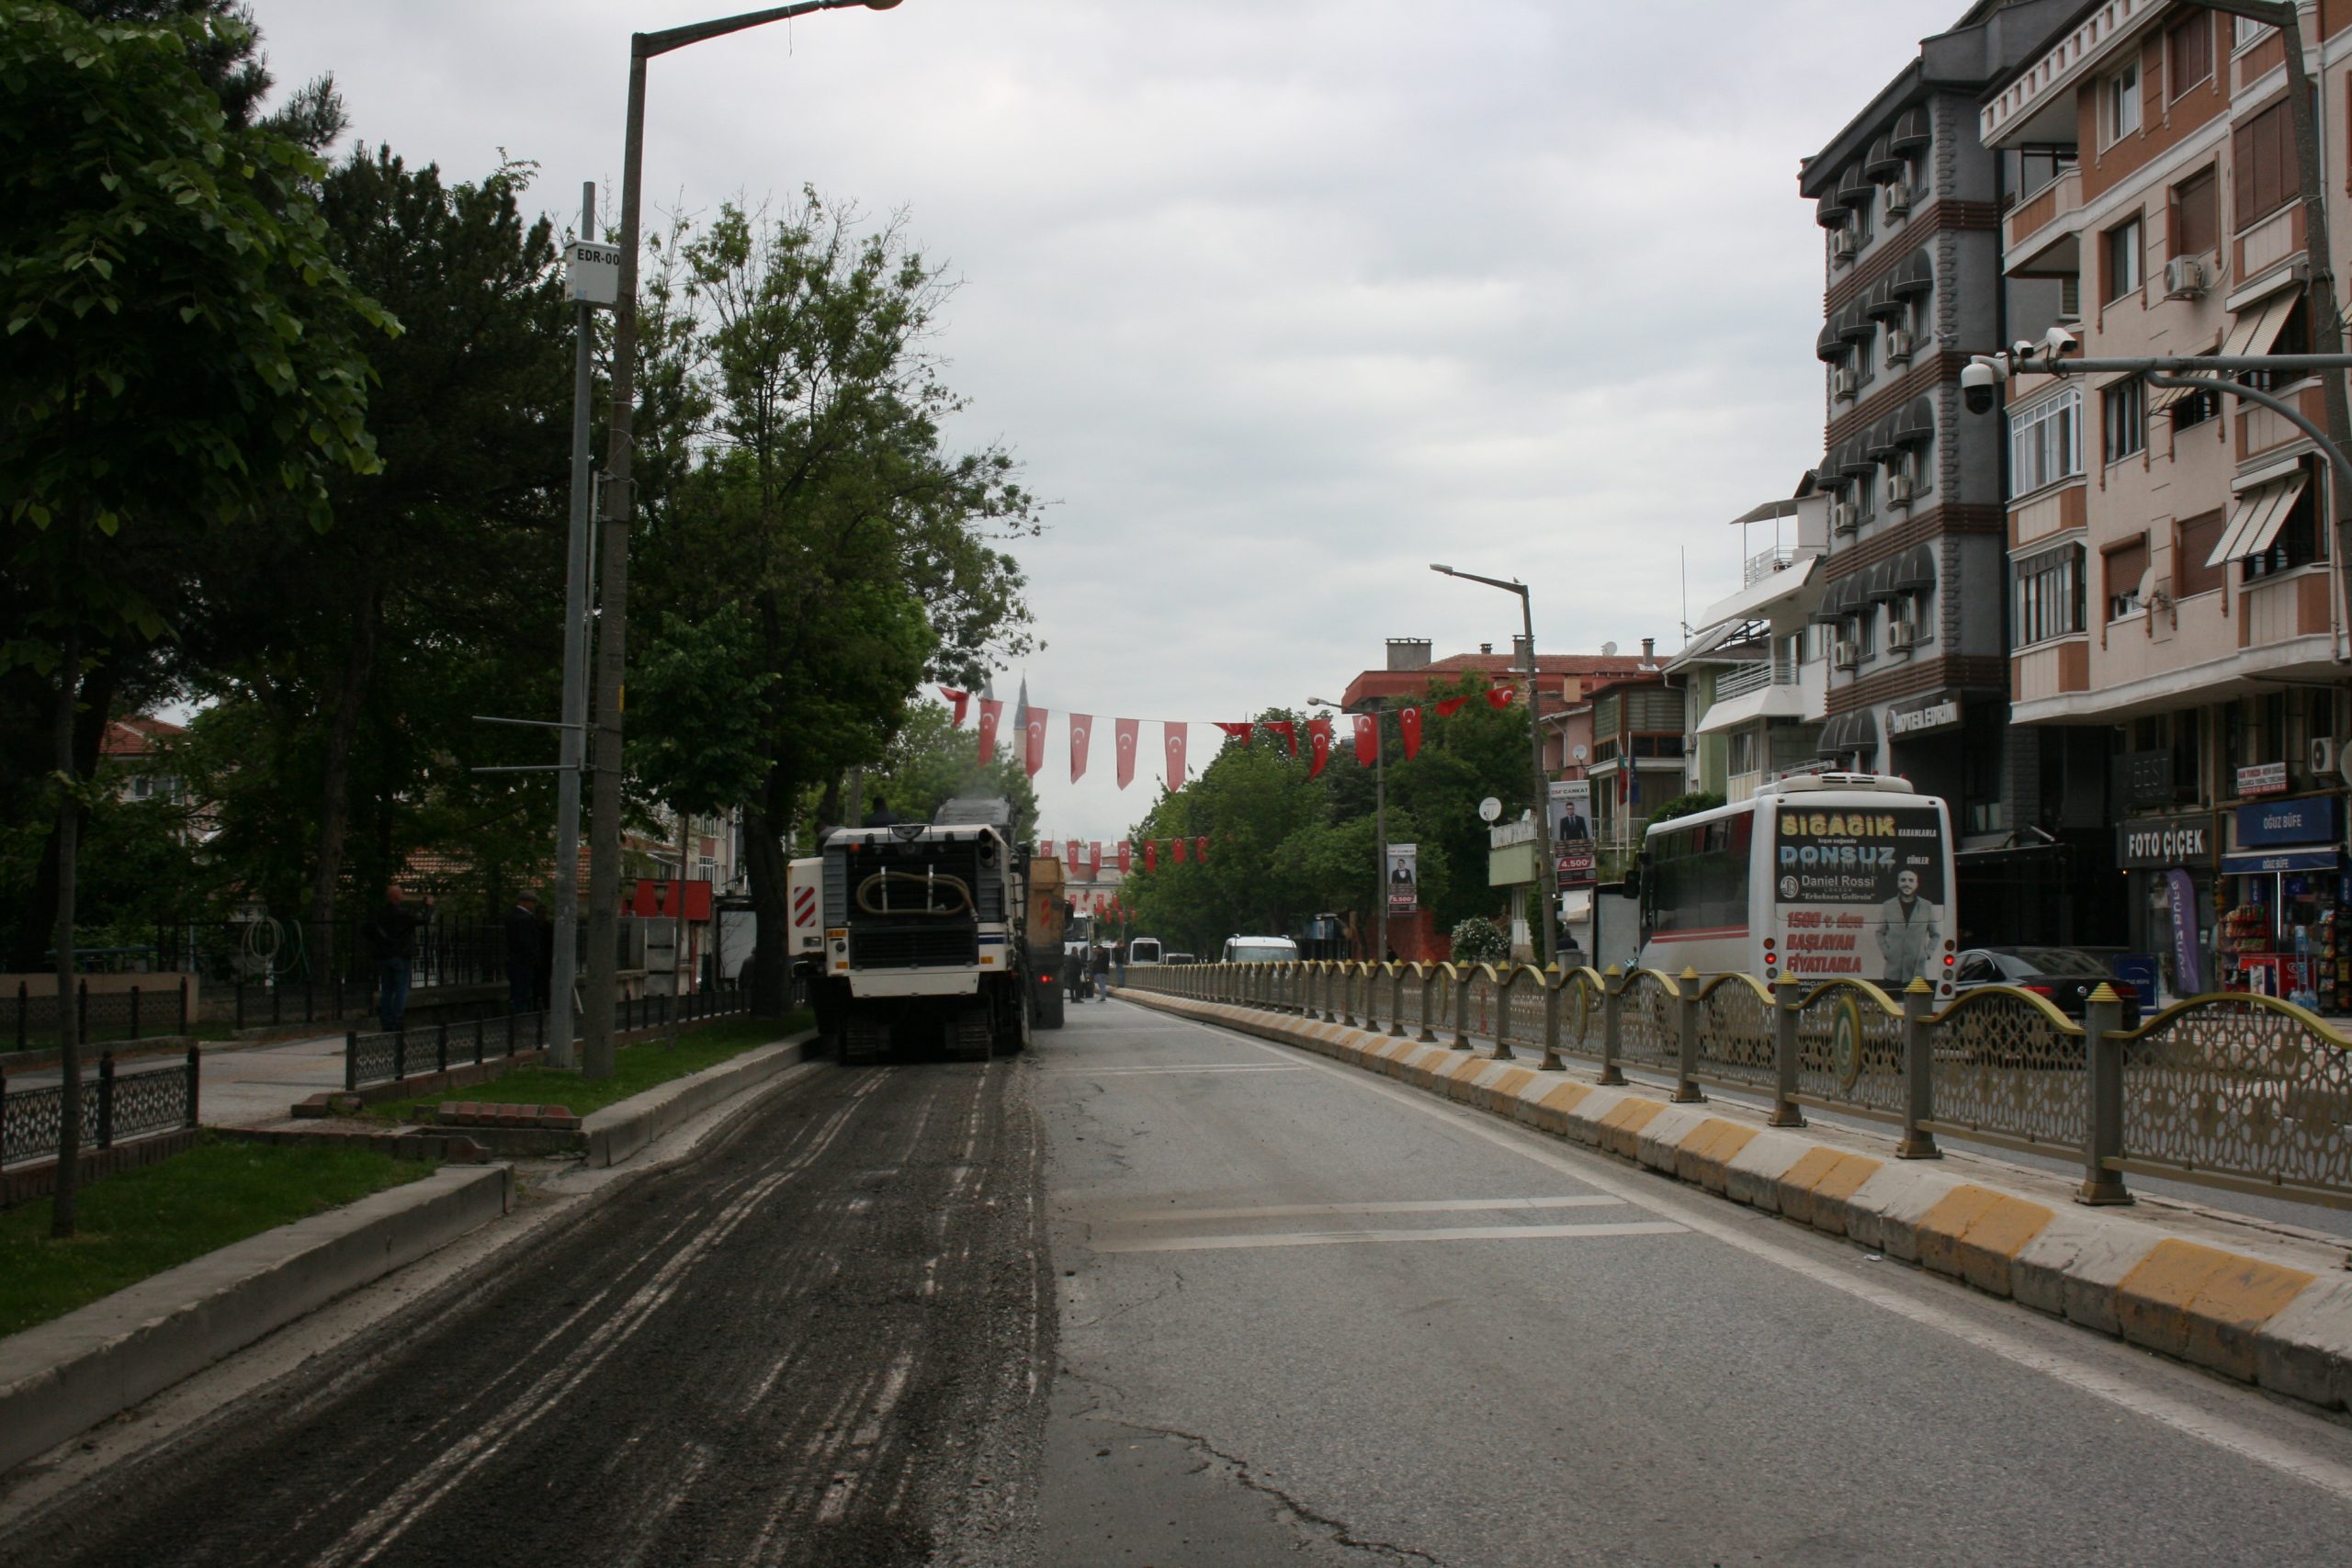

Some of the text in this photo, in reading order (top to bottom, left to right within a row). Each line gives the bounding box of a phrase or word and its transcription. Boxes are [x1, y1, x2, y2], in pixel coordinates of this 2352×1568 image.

[2263, 812, 2301, 829] OĞUZ BÜFE
[2129, 823, 2204, 863] FOTO ÇİÇEK
[1781, 845, 1896, 866] DONSUZ
[1802, 875, 1875, 887] Daniel Rossi
[1786, 934, 1856, 953] BAŞLAYAN
[1787, 953, 1861, 973] FİYATLARLA
